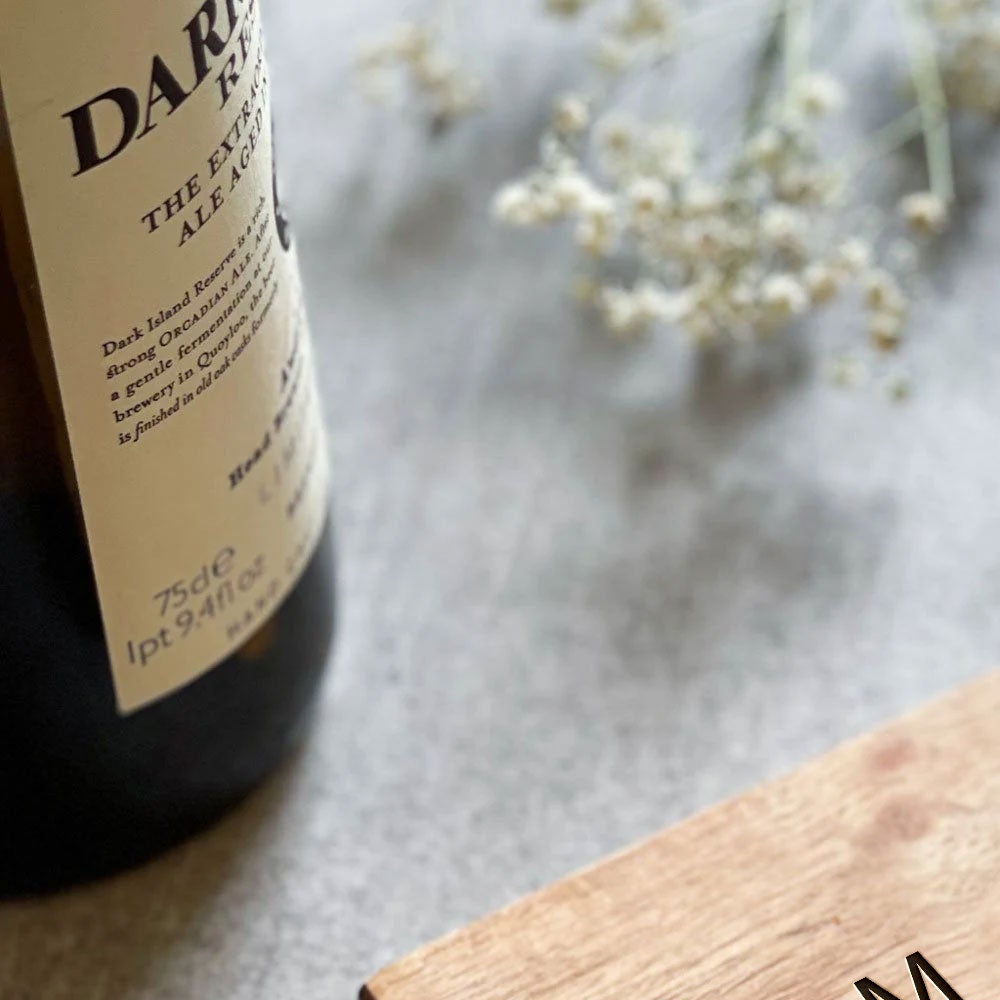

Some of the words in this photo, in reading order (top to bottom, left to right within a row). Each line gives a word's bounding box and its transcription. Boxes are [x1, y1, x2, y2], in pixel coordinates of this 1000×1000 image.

[141, 173, 201, 234] THE
[178, 186, 224, 247] ALE
[229, 106, 263, 193] AGED
[101, 326, 145, 358] Dark
[147, 291, 191, 332] Island
[193, 248, 237, 298] Reserve
[110, 391, 121, 401] a
[126, 359, 174, 398] gentle
[177, 280, 252, 360] fermentation
[106, 345, 157, 380] strong
[112, 380, 176, 423] brewery
[178, 368, 194, 385] in
[118, 432, 133, 446] is
[133, 396, 180, 442] finished
[182, 392, 195, 406] in
[196, 371, 213, 395] old
